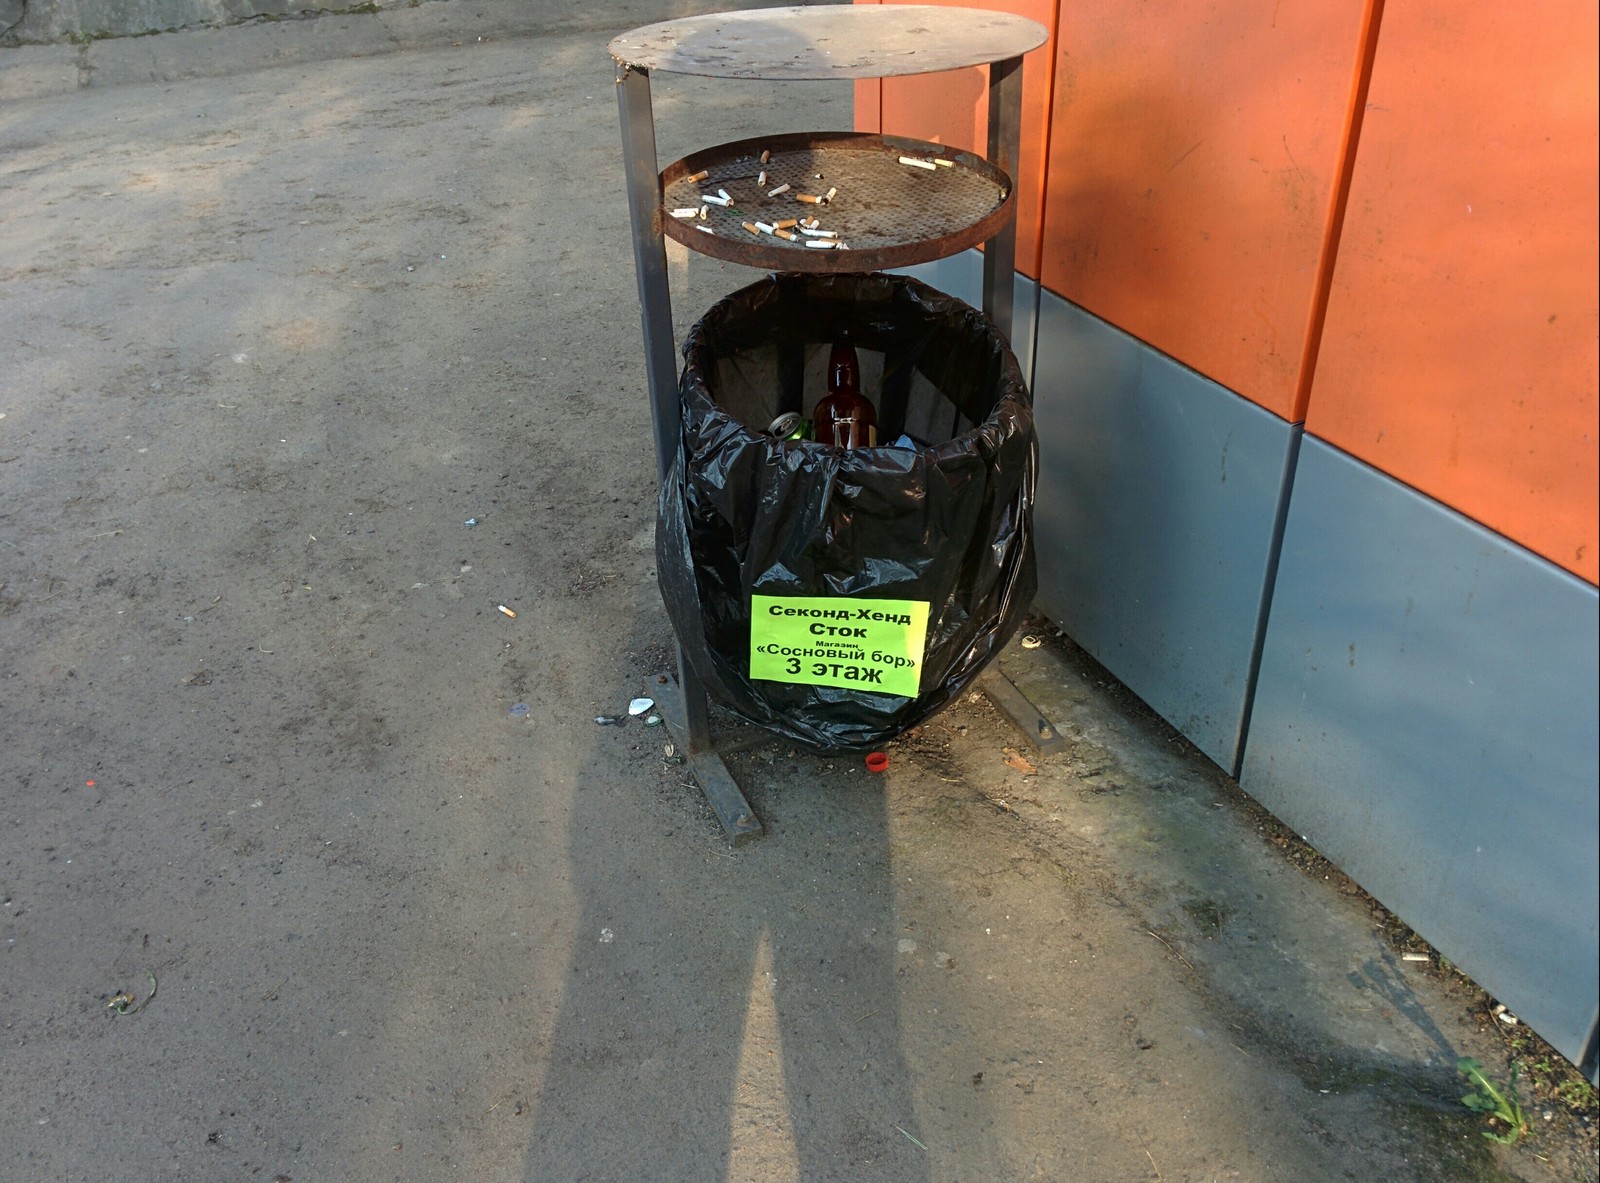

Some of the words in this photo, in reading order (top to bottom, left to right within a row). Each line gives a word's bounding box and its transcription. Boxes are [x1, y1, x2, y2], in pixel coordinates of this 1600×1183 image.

[769, 605, 911, 625] Секонд-Хенд
[809, 623, 868, 638] Сток
[815, 640, 859, 649] Магазин
[756, 643, 865, 661] «Сосновый
[871, 651, 916, 668] бор»
[785, 658, 802, 675] 3
[811, 662, 884, 684] этаж
